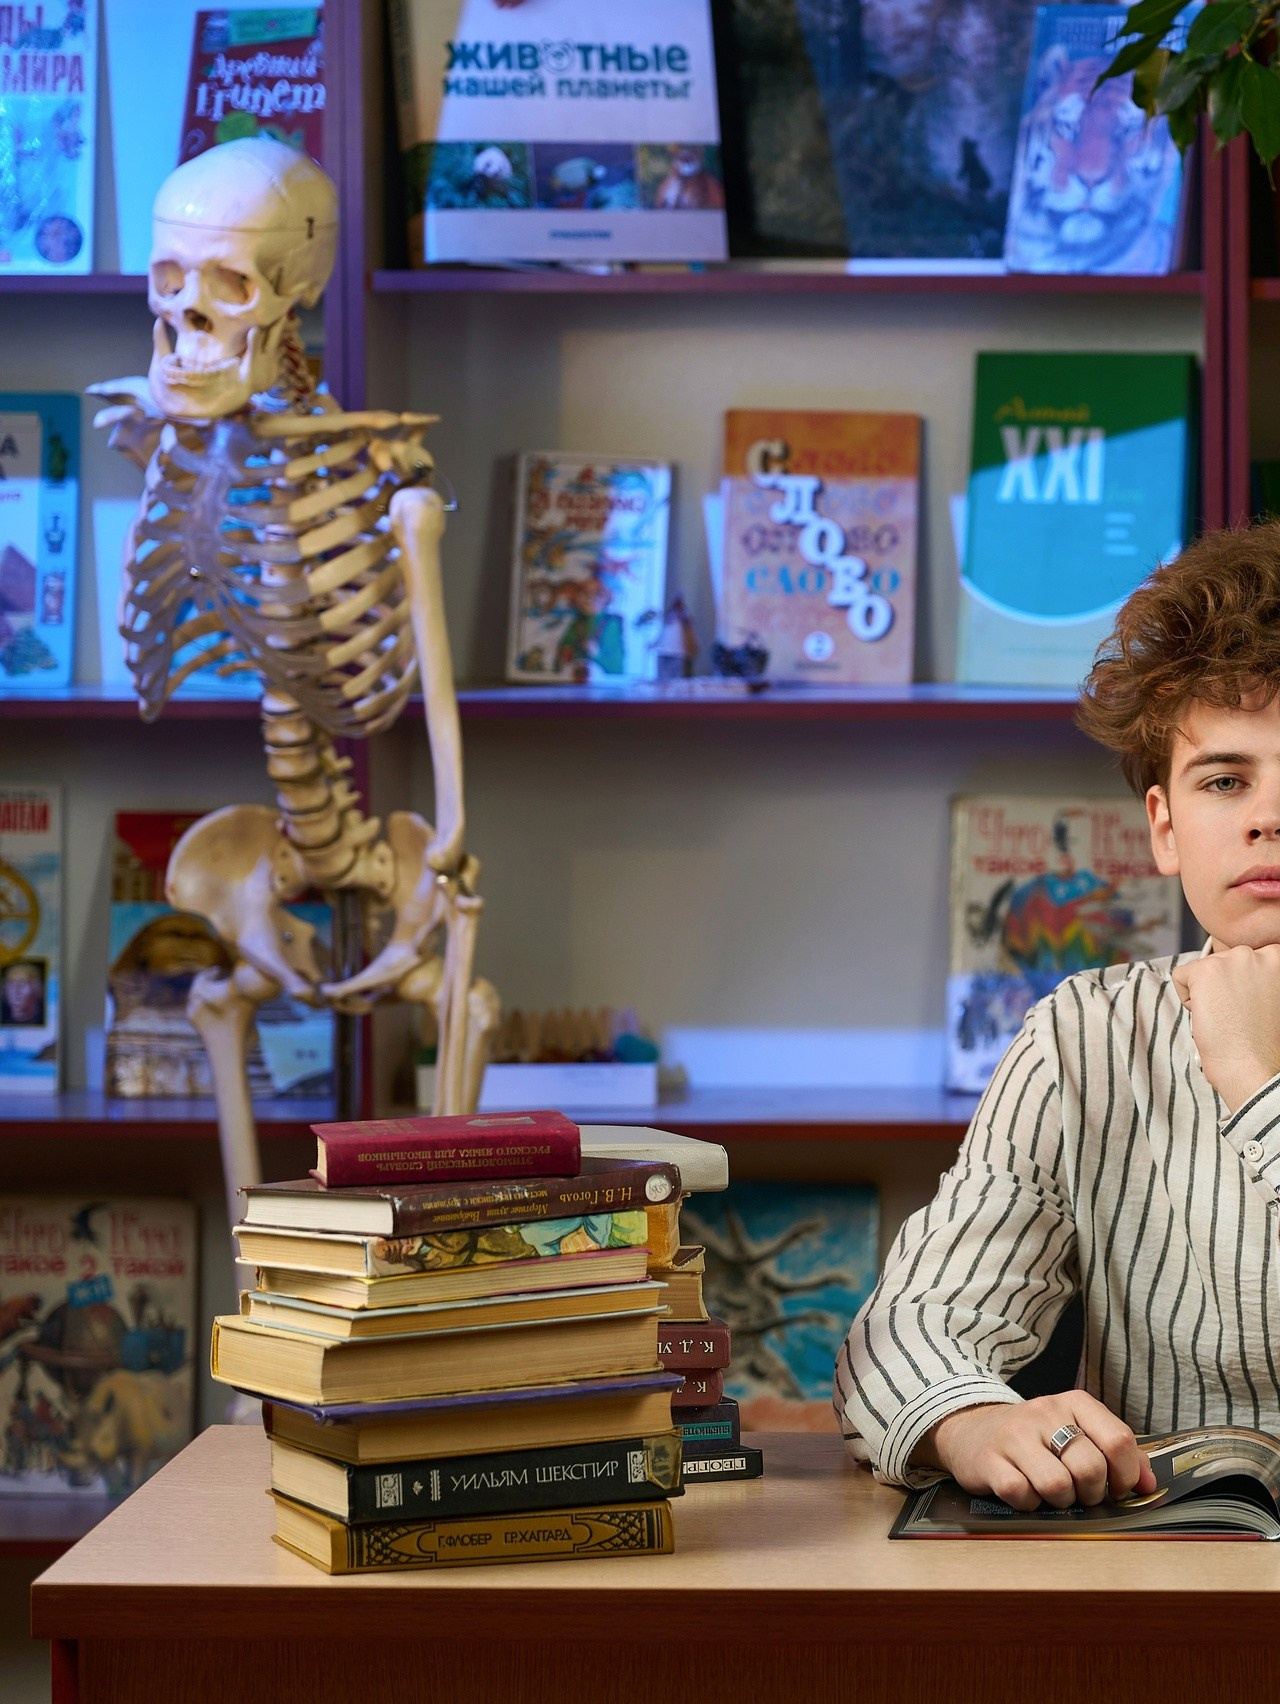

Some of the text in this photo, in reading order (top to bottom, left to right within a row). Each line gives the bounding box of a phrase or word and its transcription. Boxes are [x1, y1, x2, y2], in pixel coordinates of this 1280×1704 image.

[443, 73, 694, 99] нашей планеты
[195, 79, 326, 121] Египет
[998, 425, 1104, 503] XXI
[358, 1145, 550, 1163] РУССКОГО ЯЗЫКА ДЛЯ ШКОЛЬНИКОВ
[376, 1155, 534, 1173] ЭТИМОЛОГИЧЕСКИЙ СЛОВАРЬ
[559, 1187, 632, 1206] Н. В. Гоголь
[678, 1340, 694, 1353] Д.
[700, 1341, 714, 1353] К.
[693, 1381, 707, 1393] К.
[450, 1459, 619, 1493] УИЛЬЯМ ШЕКСПИР
